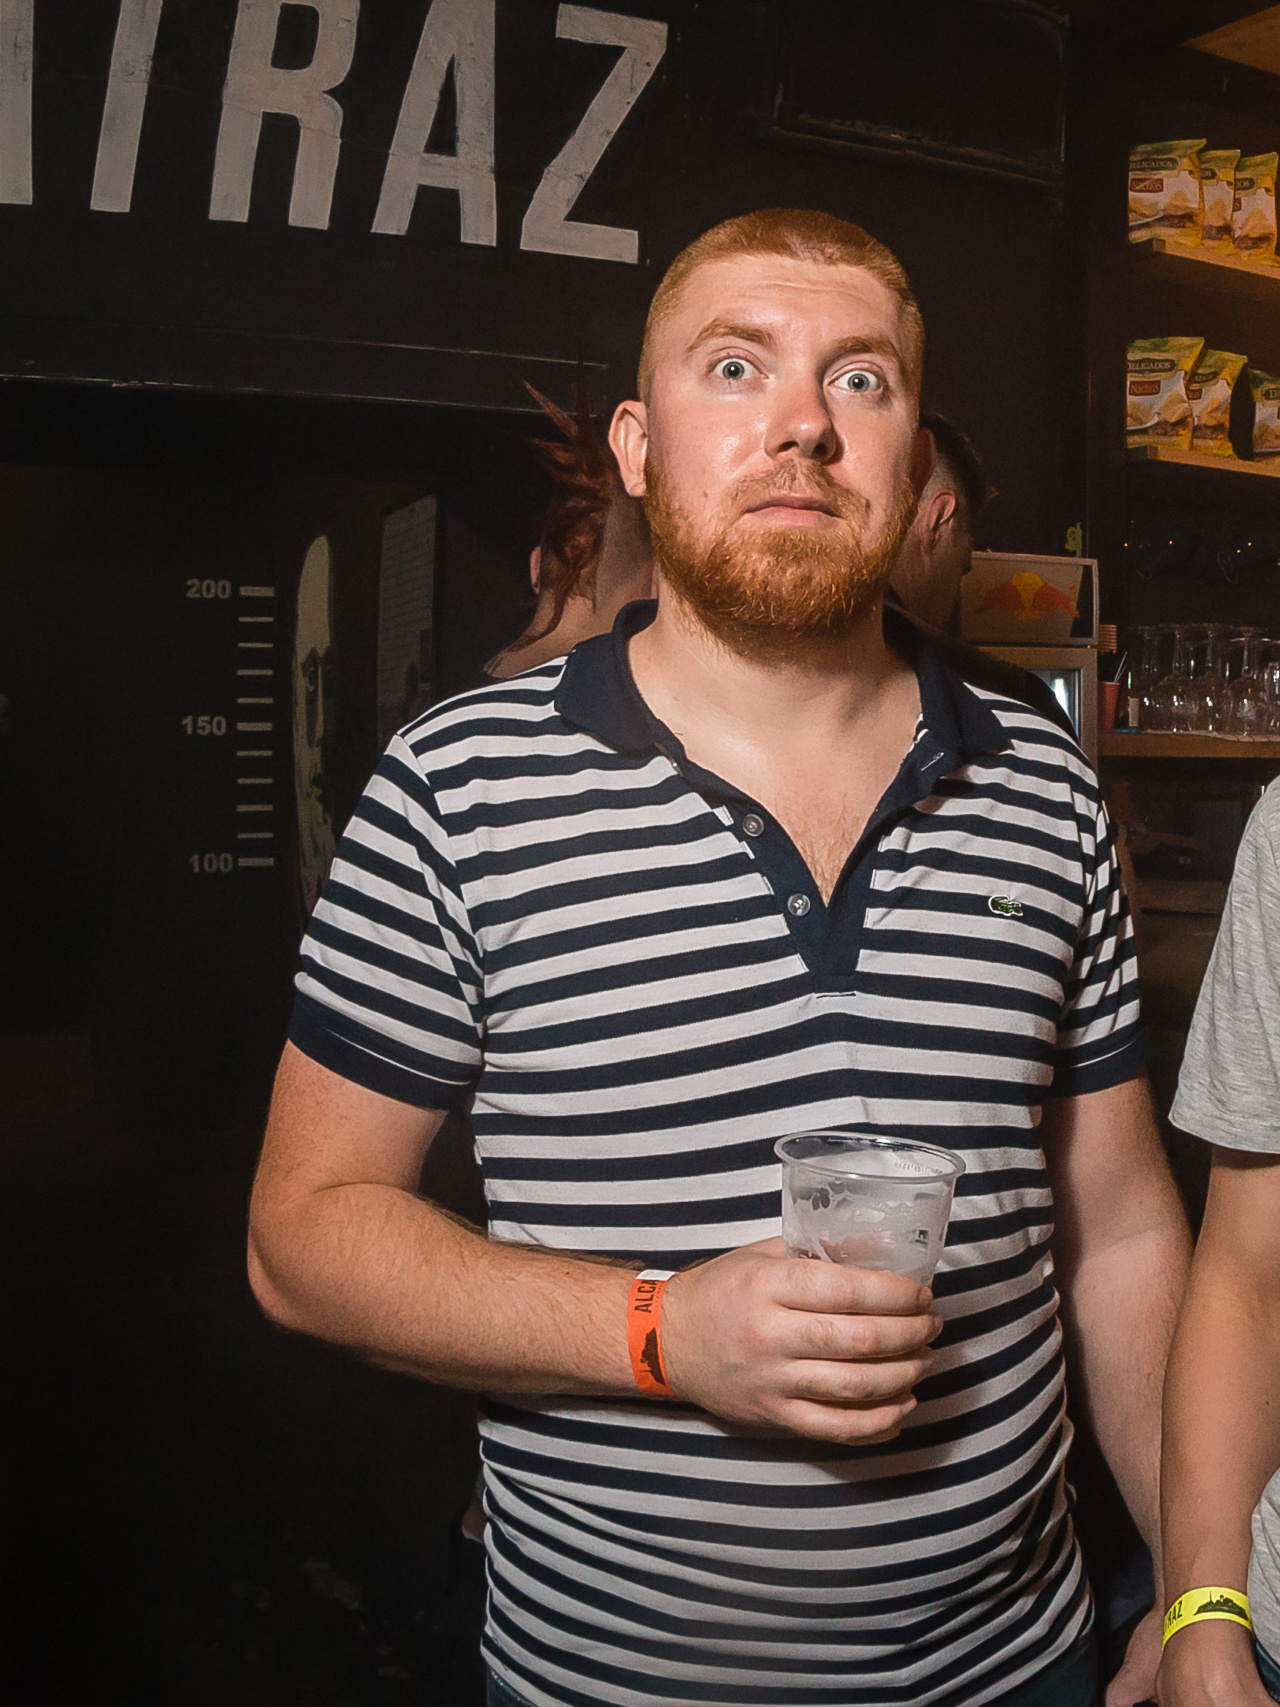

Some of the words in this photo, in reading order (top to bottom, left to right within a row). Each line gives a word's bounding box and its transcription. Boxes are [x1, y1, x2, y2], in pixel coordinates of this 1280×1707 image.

[186, 578, 232, 599] 200
[182, 715, 227, 736] 150
[188, 853, 234, 874] 100
